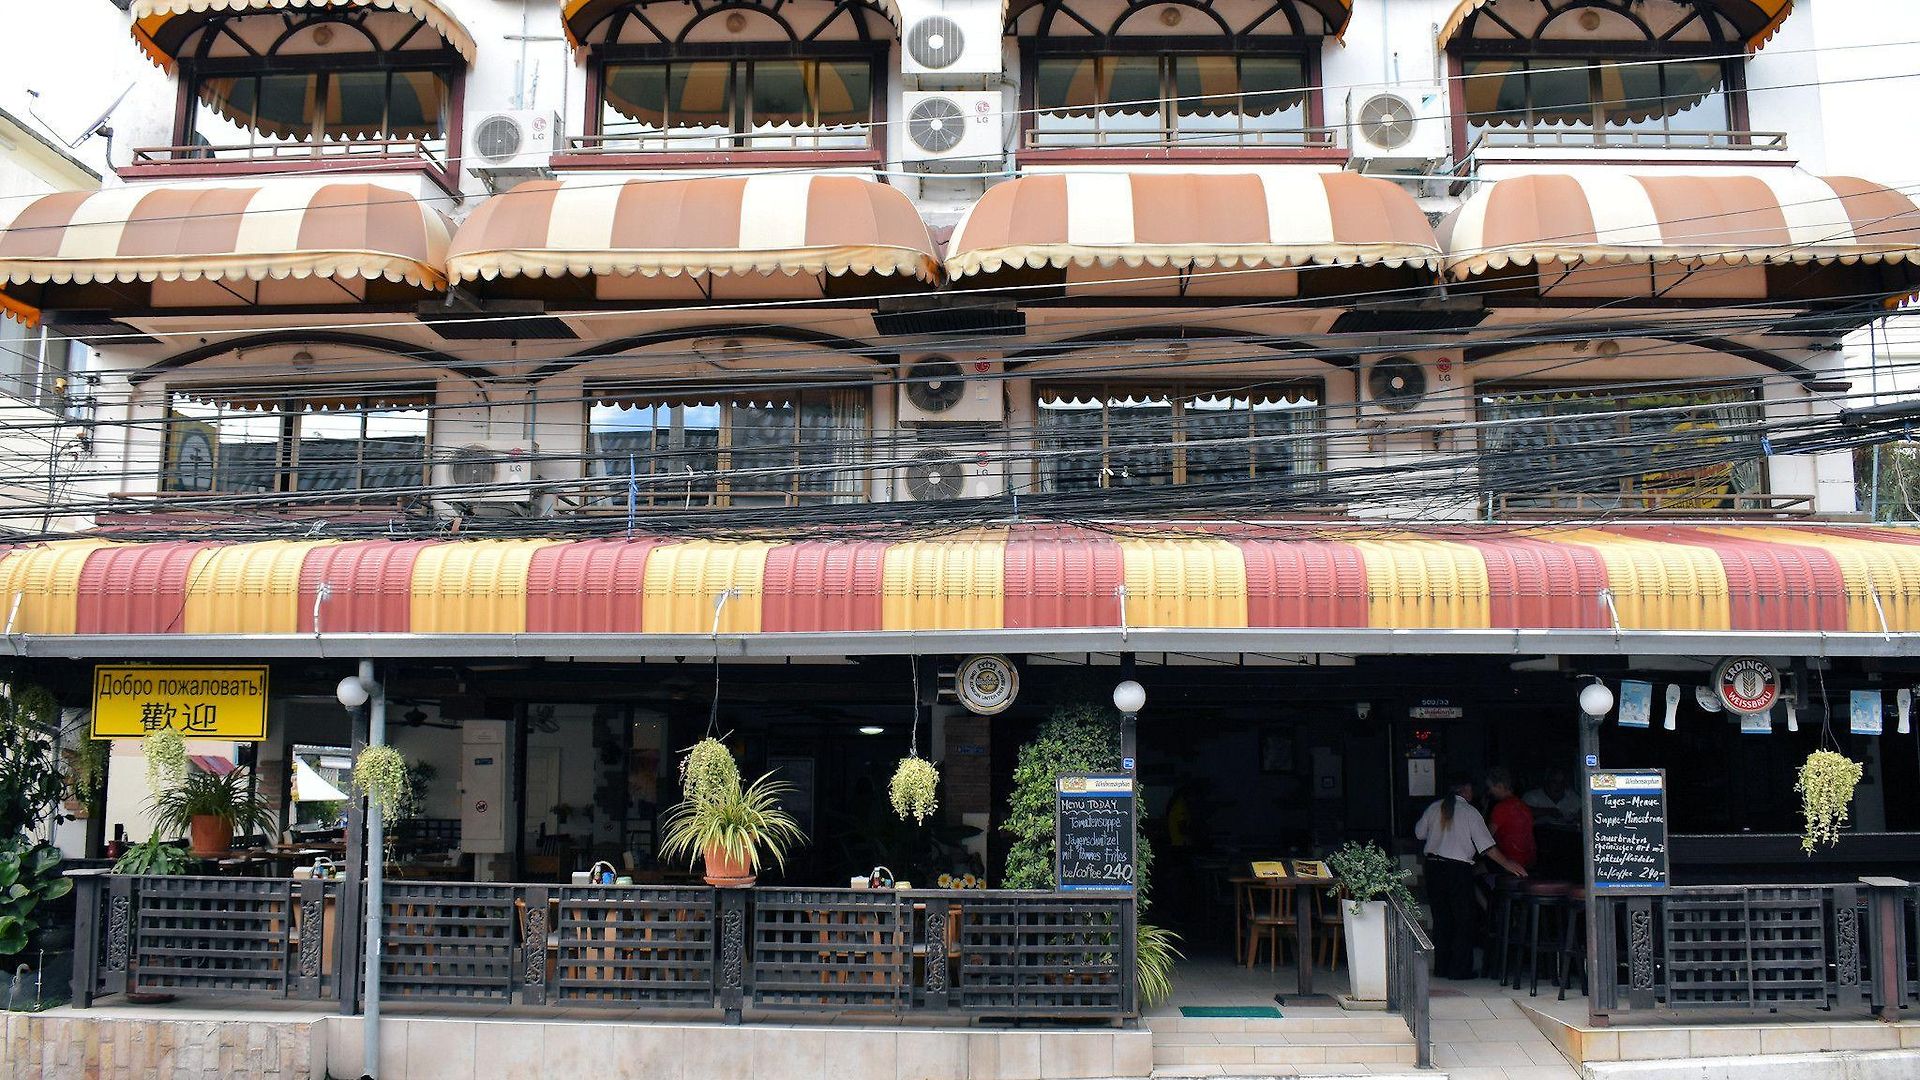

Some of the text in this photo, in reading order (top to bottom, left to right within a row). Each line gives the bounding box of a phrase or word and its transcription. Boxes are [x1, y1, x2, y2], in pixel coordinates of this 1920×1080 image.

[1725, 660, 1773, 682] ERDINGER
[100, 674, 263, 700] Добро пожаловать!
[1087, 799, 1118, 810] TODAY
